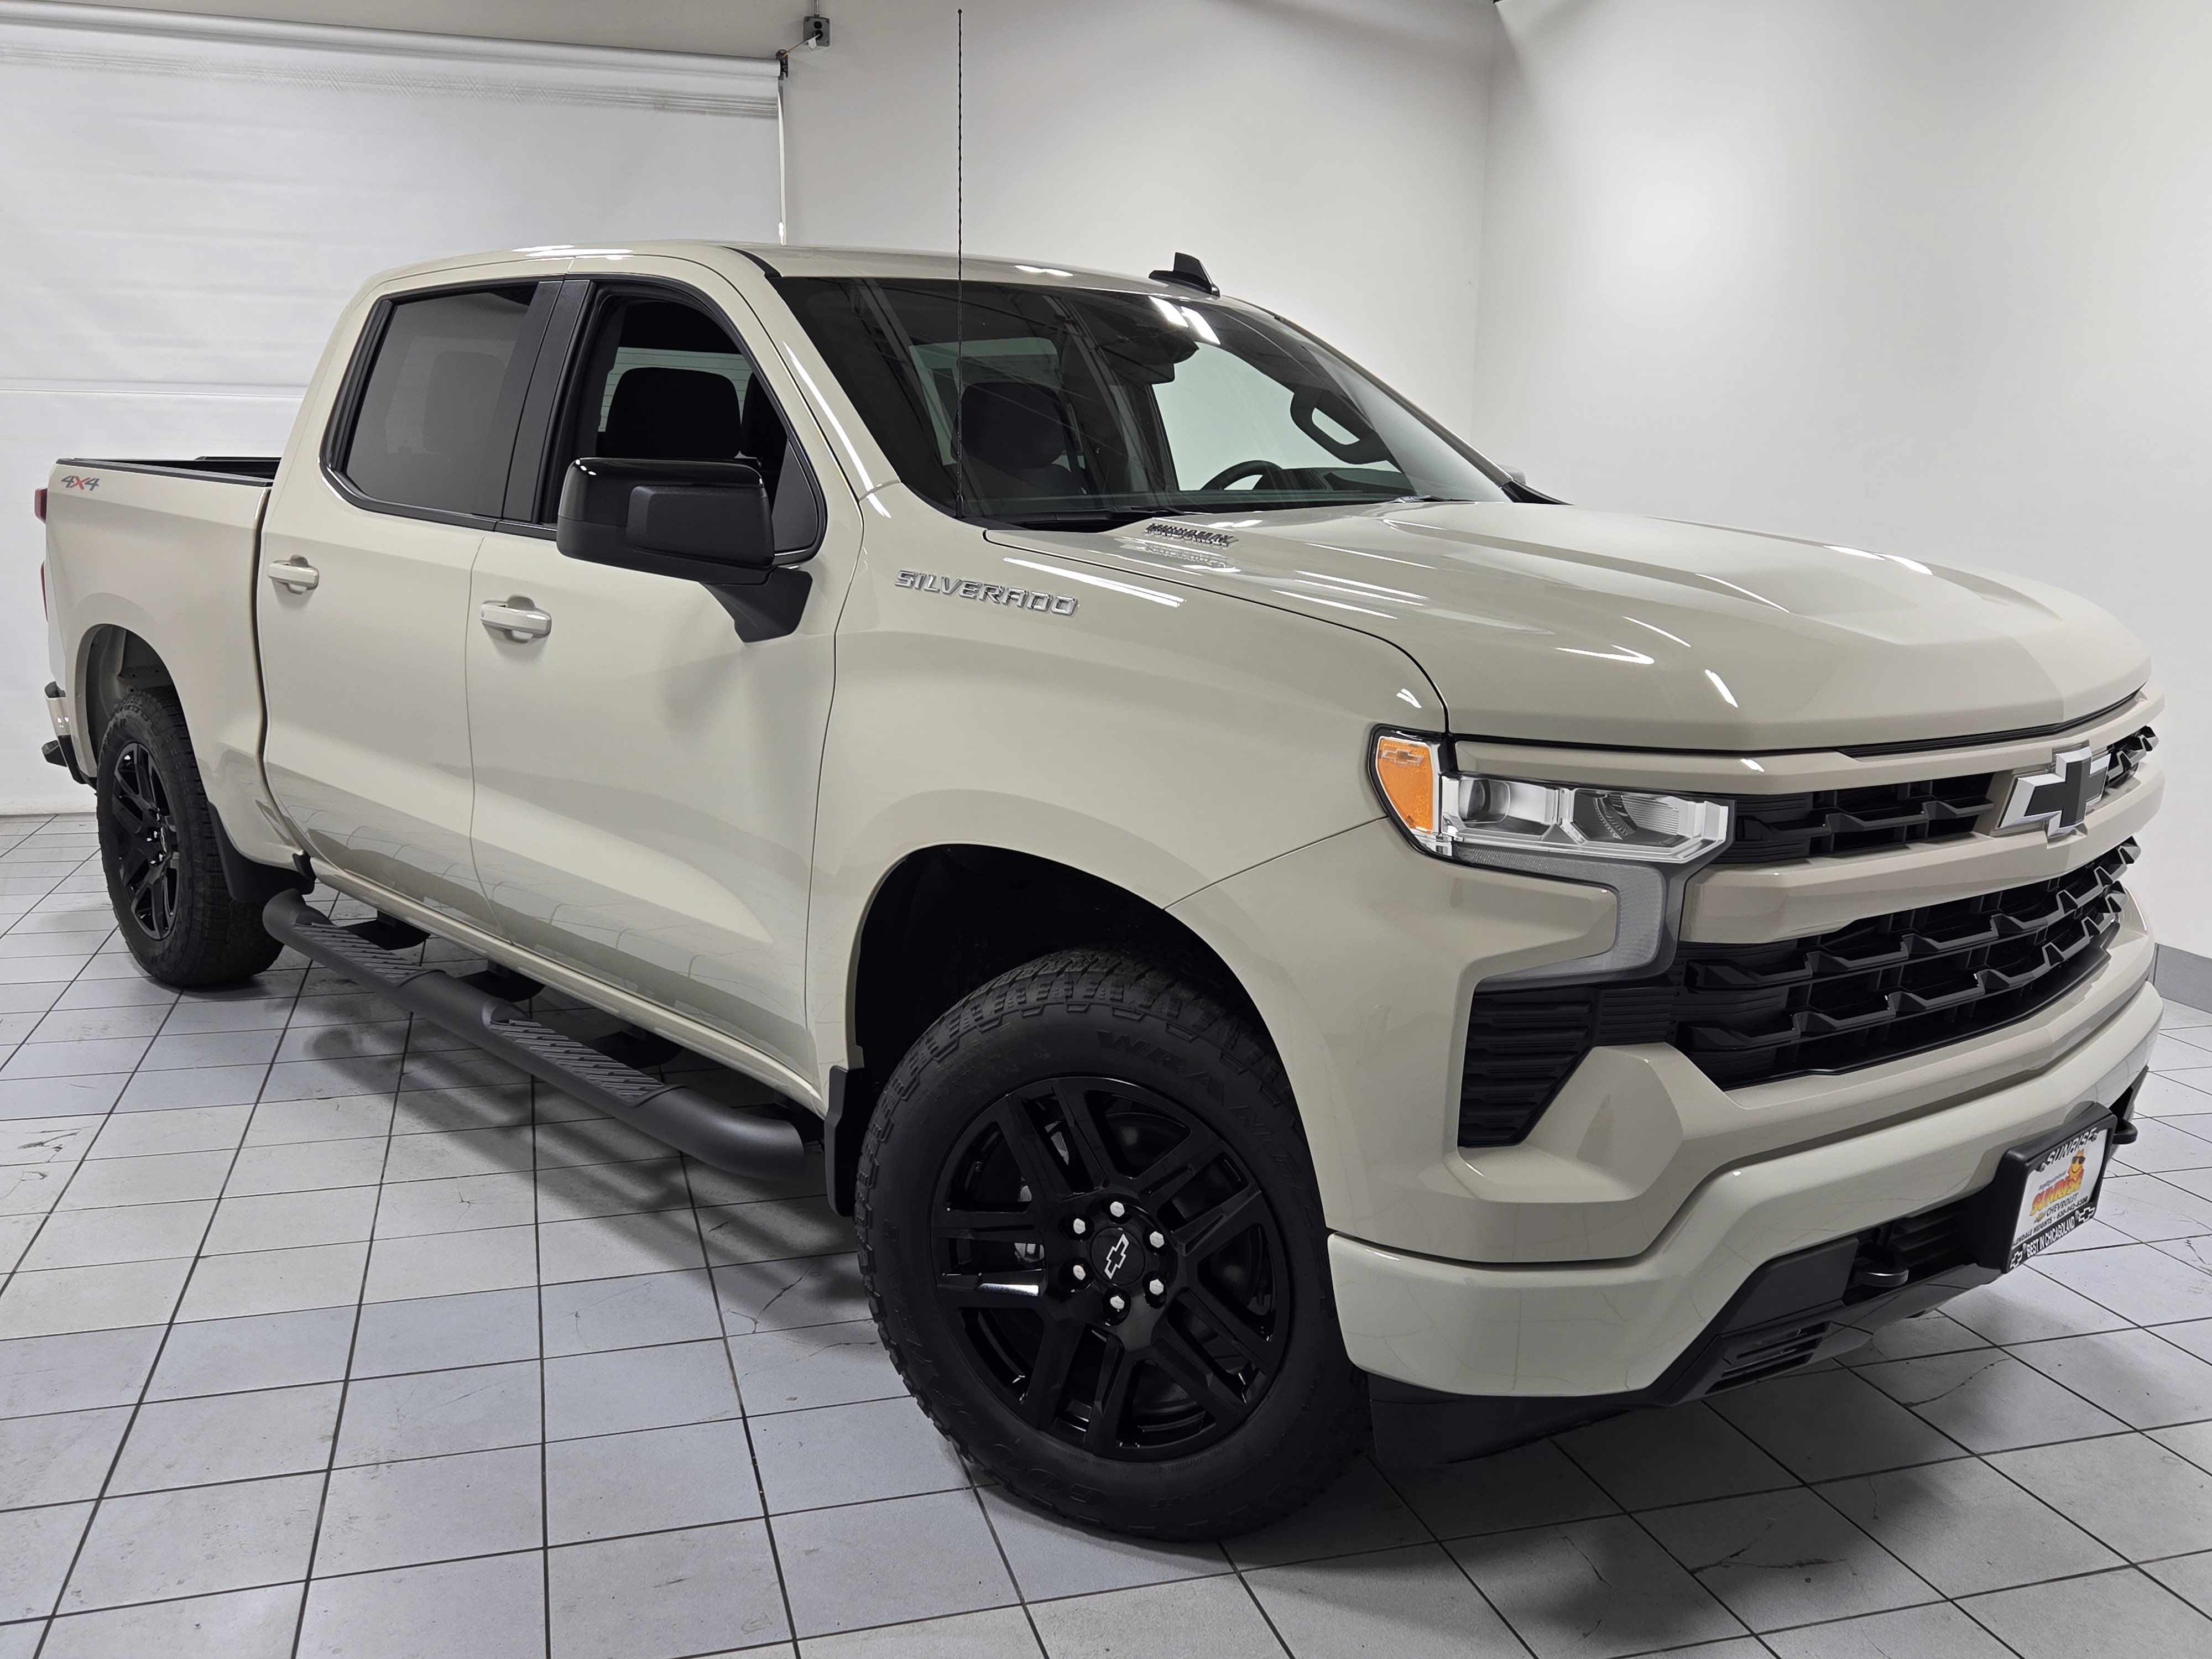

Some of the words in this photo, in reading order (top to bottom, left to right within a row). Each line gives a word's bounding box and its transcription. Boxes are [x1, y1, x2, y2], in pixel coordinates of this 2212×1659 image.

[894, 570, 1079, 616] SILVERADO
[2047, 1127, 2098, 1165] SUNRISE
[1095, 1029, 1337, 1319] WRANGLER
[2030, 1168, 2085, 1216] SUNRISE
[2046, 1192, 2079, 1216] CHEVROLET
[2012, 1228, 2033, 1246] LENDALE
[2026, 1238, 2039, 1258] BEST
[2039, 1235, 2045, 1250] IN
[2045, 1216, 2075, 1247] CHICAGOLAND
